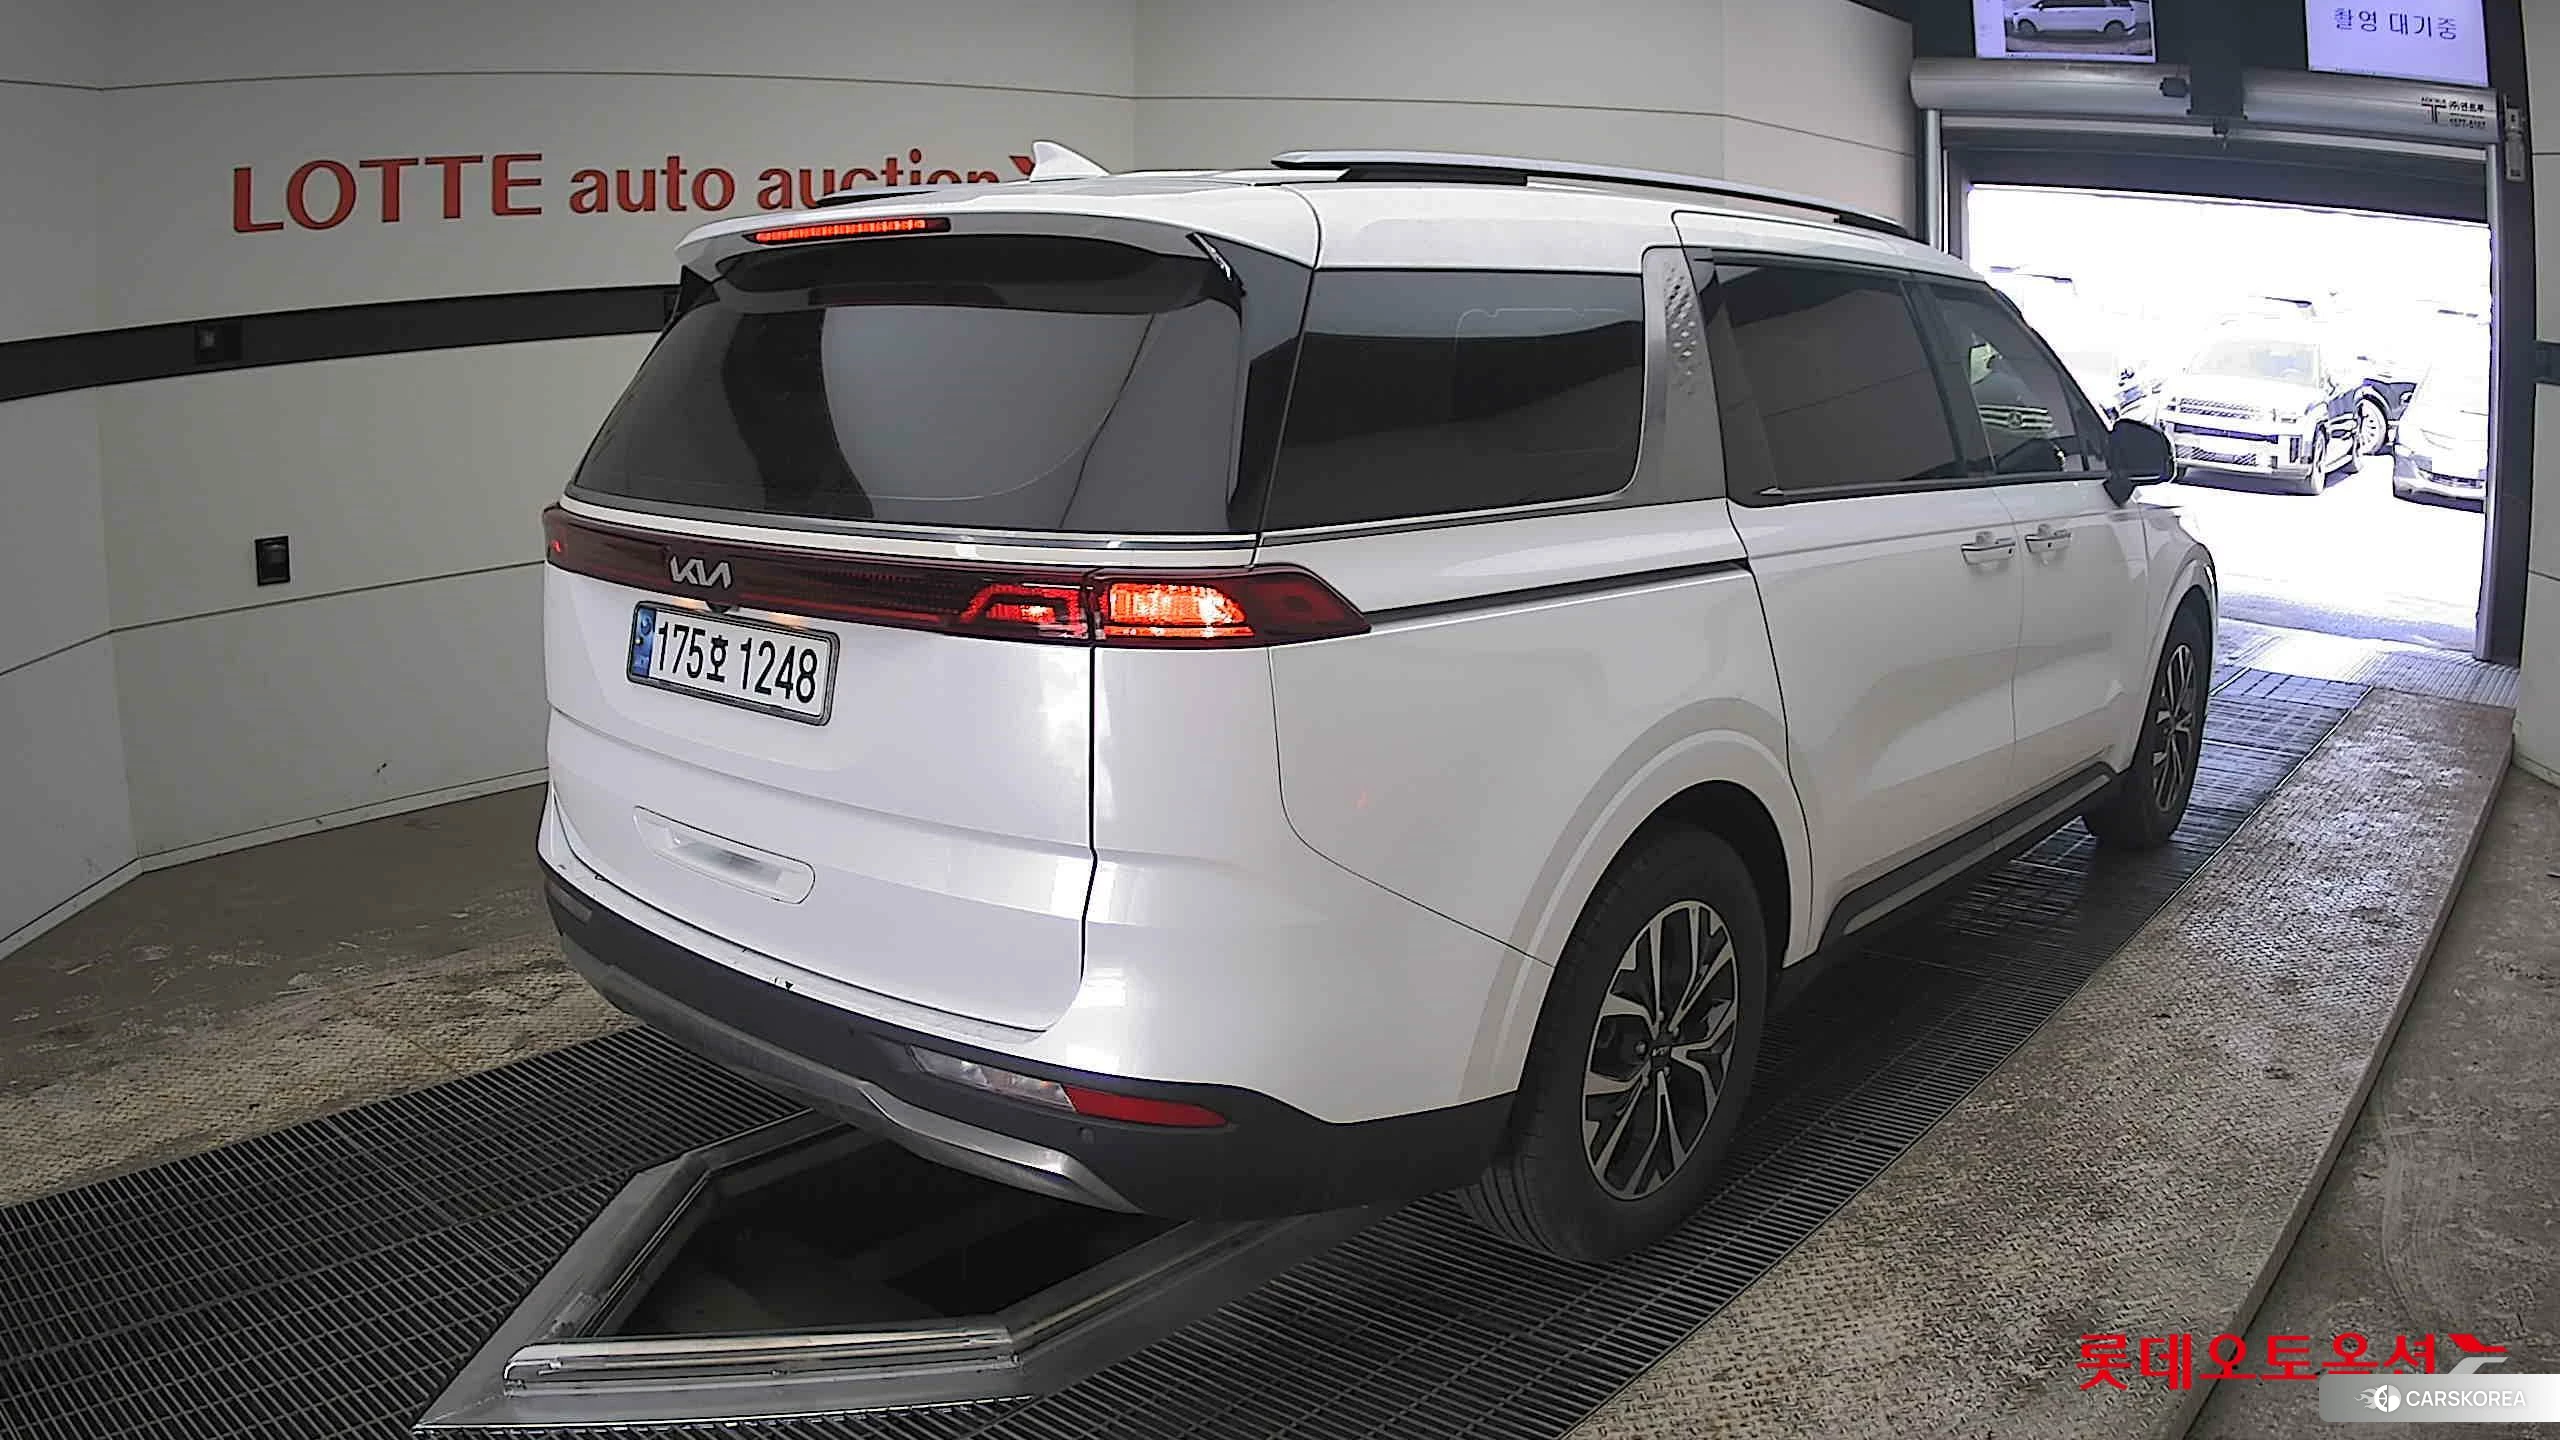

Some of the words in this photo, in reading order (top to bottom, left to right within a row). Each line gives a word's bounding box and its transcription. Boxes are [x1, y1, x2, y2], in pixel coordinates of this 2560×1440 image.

[2388, 12, 2458, 41] 대기중
[233, 153, 542, 232] LOTTE
[568, 155, 735, 213] auto
[669, 555, 735, 590] KIA
[658, 621, 729, 683] 175호
[738, 636, 819, 704] 1248
